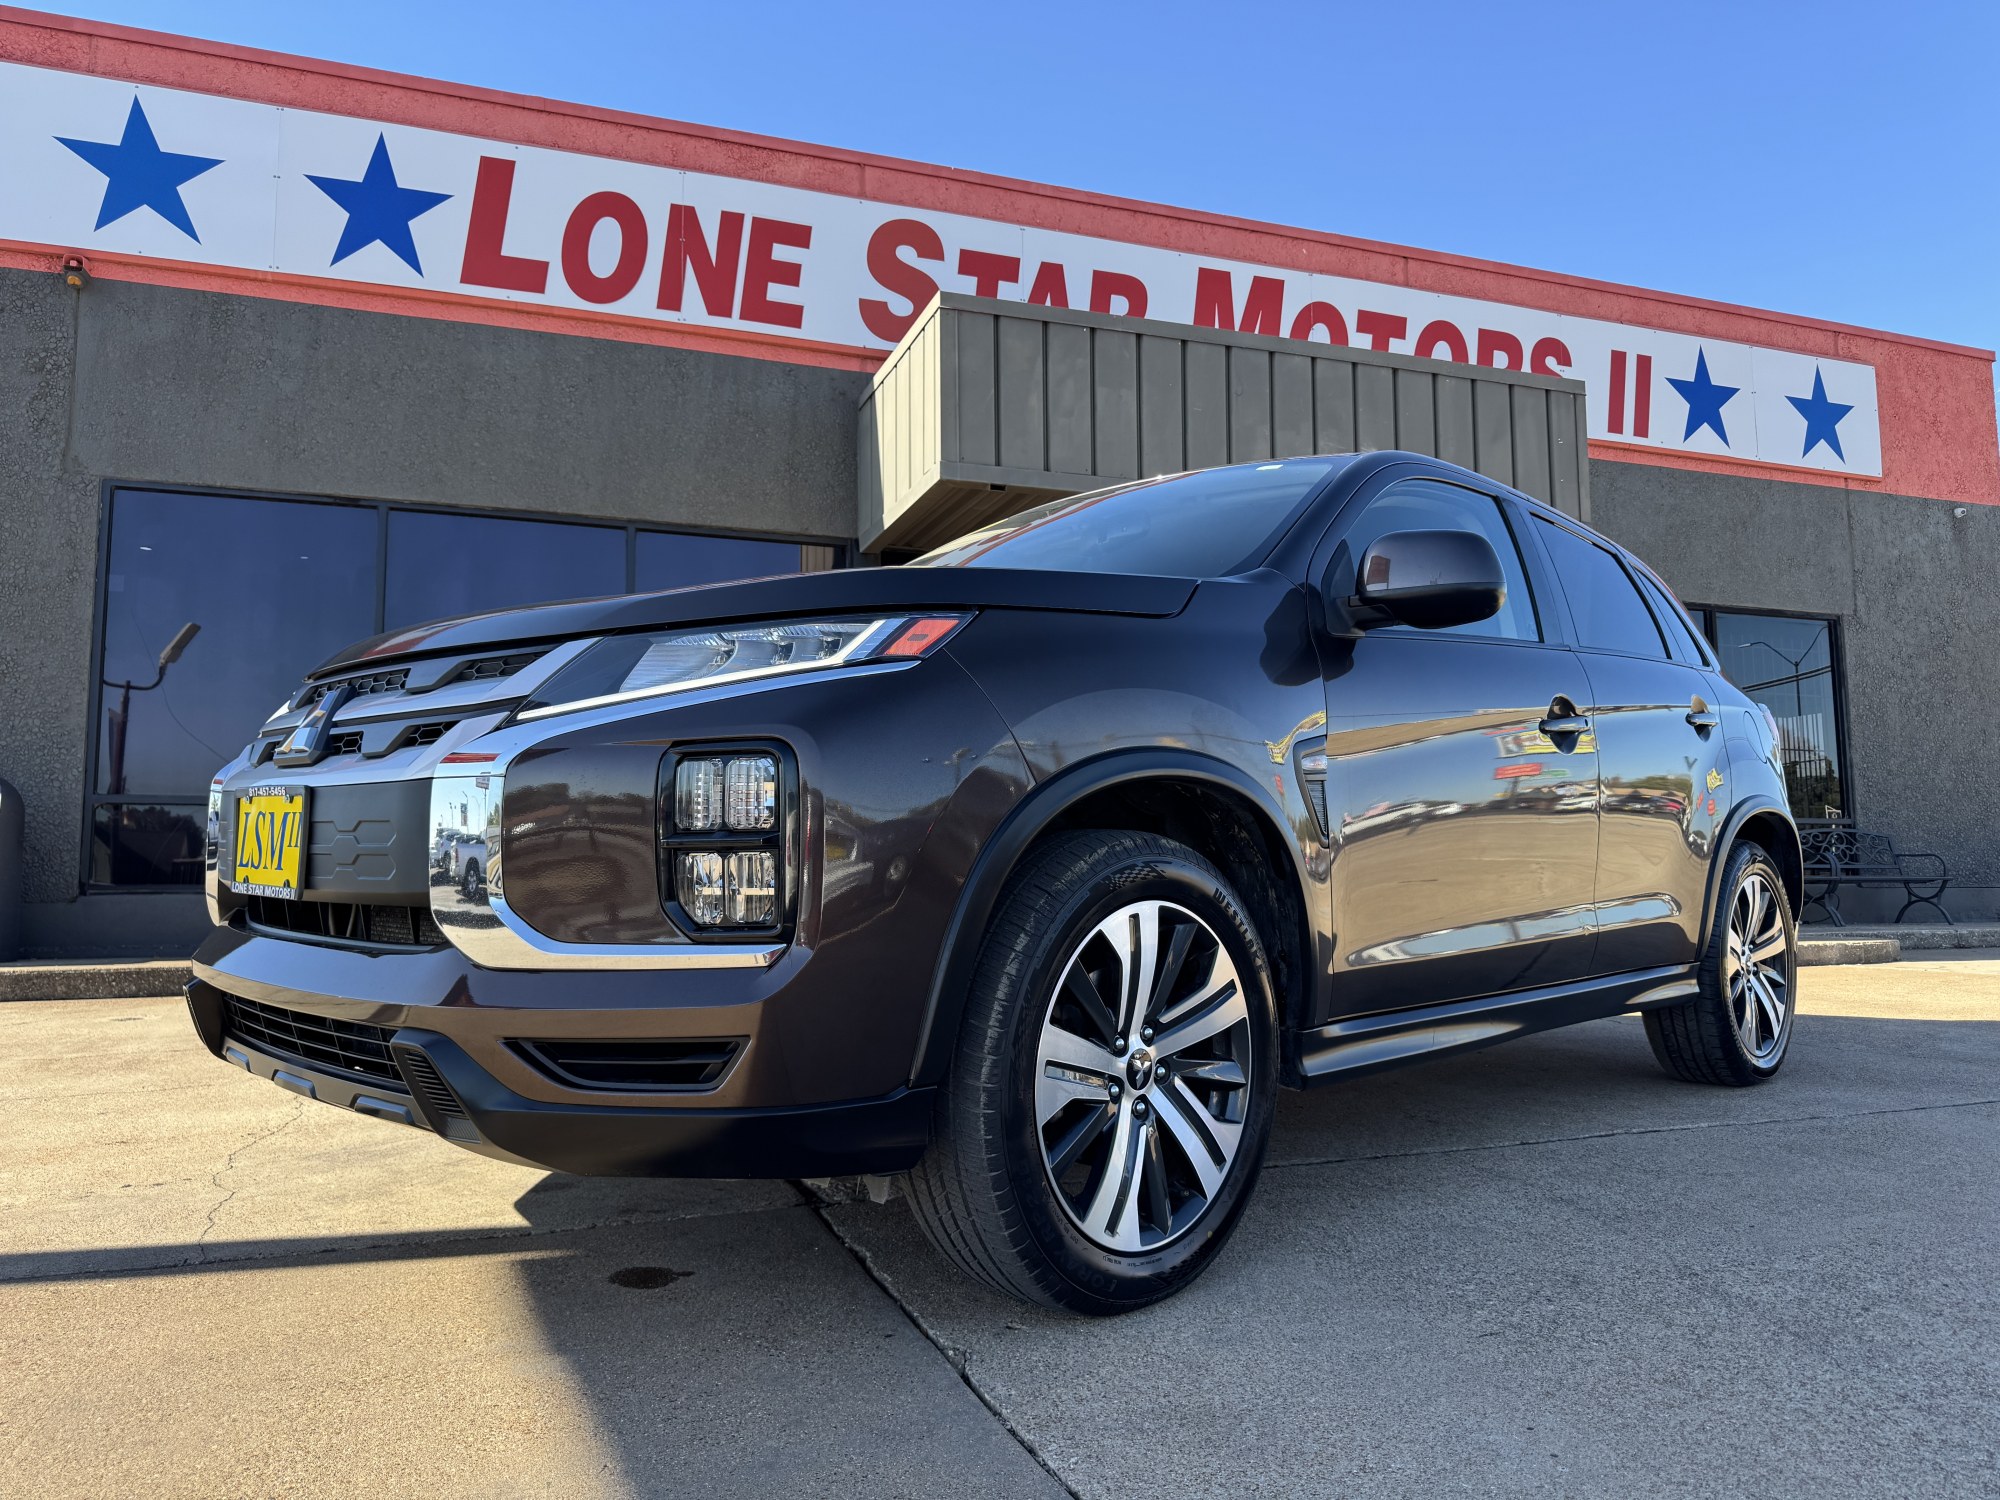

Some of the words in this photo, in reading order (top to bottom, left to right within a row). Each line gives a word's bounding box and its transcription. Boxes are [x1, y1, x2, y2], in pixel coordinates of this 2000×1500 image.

[461, 156, 812, 329] LONE
[1607, 350, 1652, 438] II
[231, 881, 249, 894] LONE
[249, 883, 264, 897] STAR
[264, 885, 290, 899] MOTORS
[1213, 886, 1266, 976] WESTLAKE
